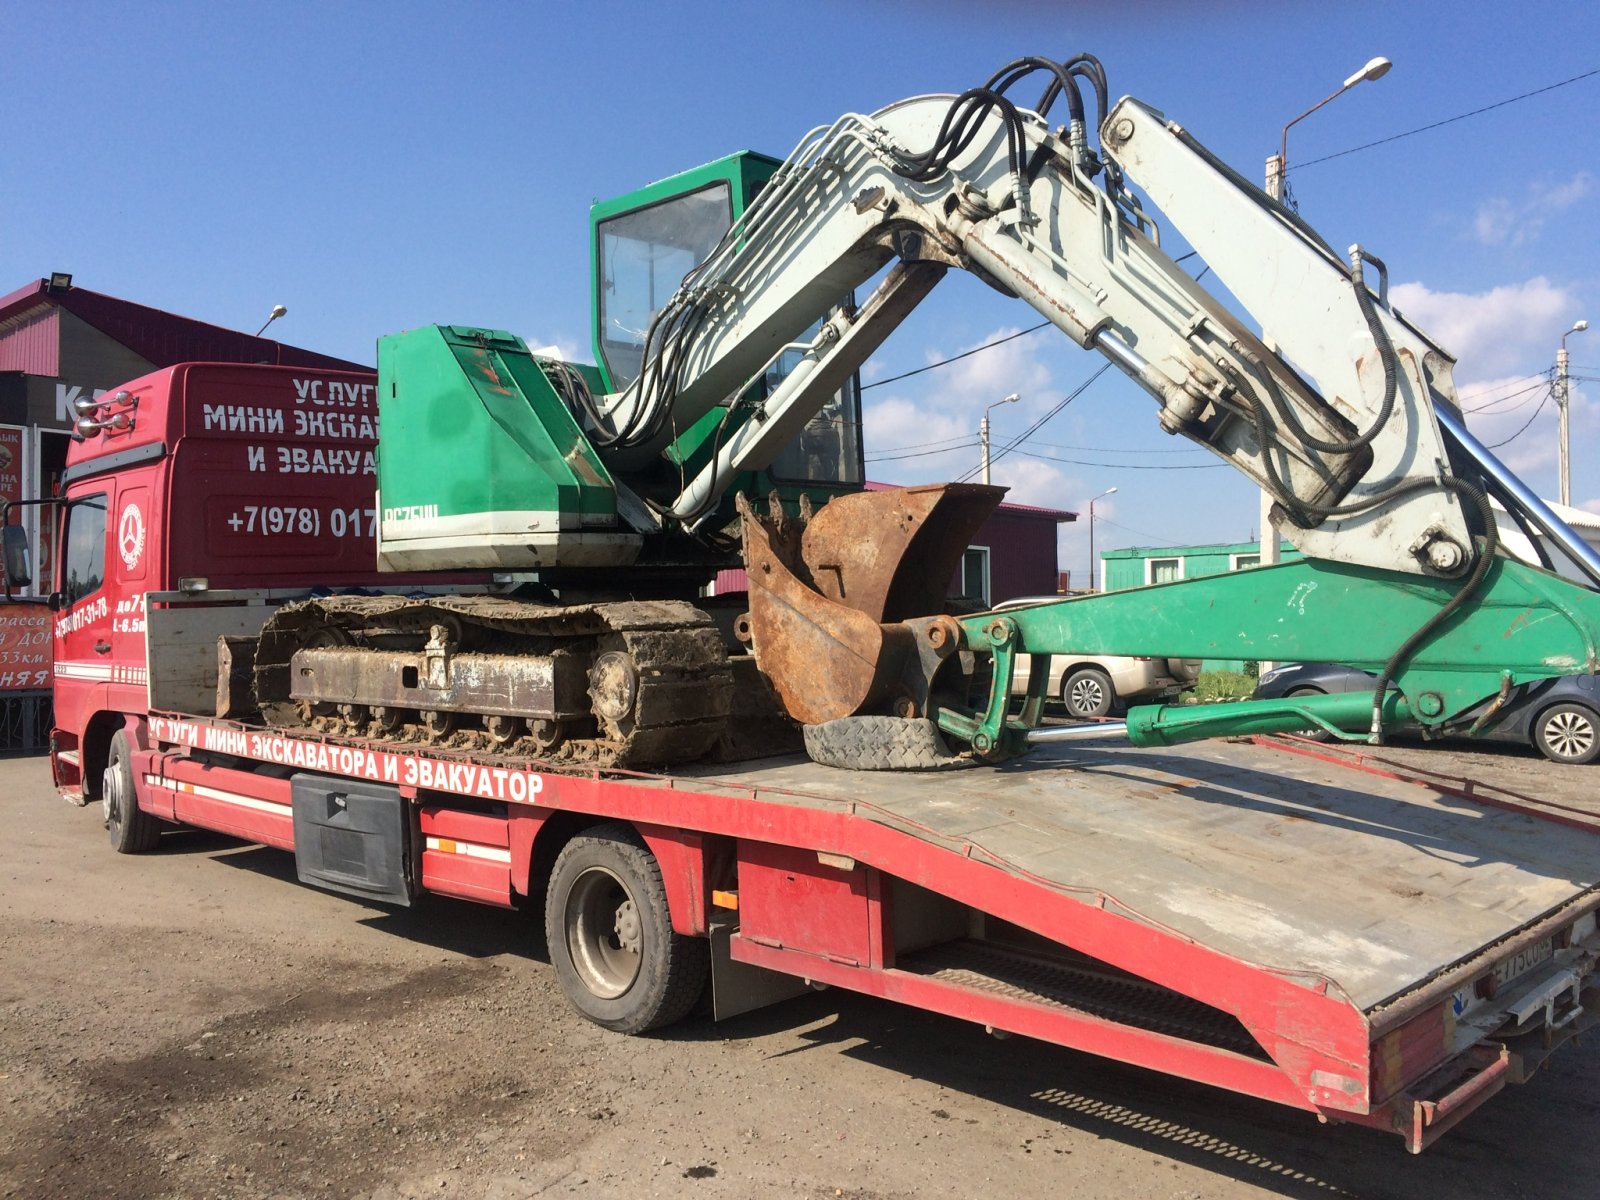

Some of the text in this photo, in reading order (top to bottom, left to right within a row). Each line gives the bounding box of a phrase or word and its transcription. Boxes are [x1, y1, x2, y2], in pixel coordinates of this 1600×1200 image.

[292, 378, 378, 407] УСЛУГ
[203, 404, 380, 440] МИНИ ЭКСКА
[247, 446, 266, 472] И
[227, 506, 377, 538] +7(978) 017
[205, 727, 248, 756] МИНИ
[251, 734, 378, 780] ЭКСКАВАТОРА
[384, 757, 399, 782] И
[404, 756, 544, 804] ЭВАКУАТОР
